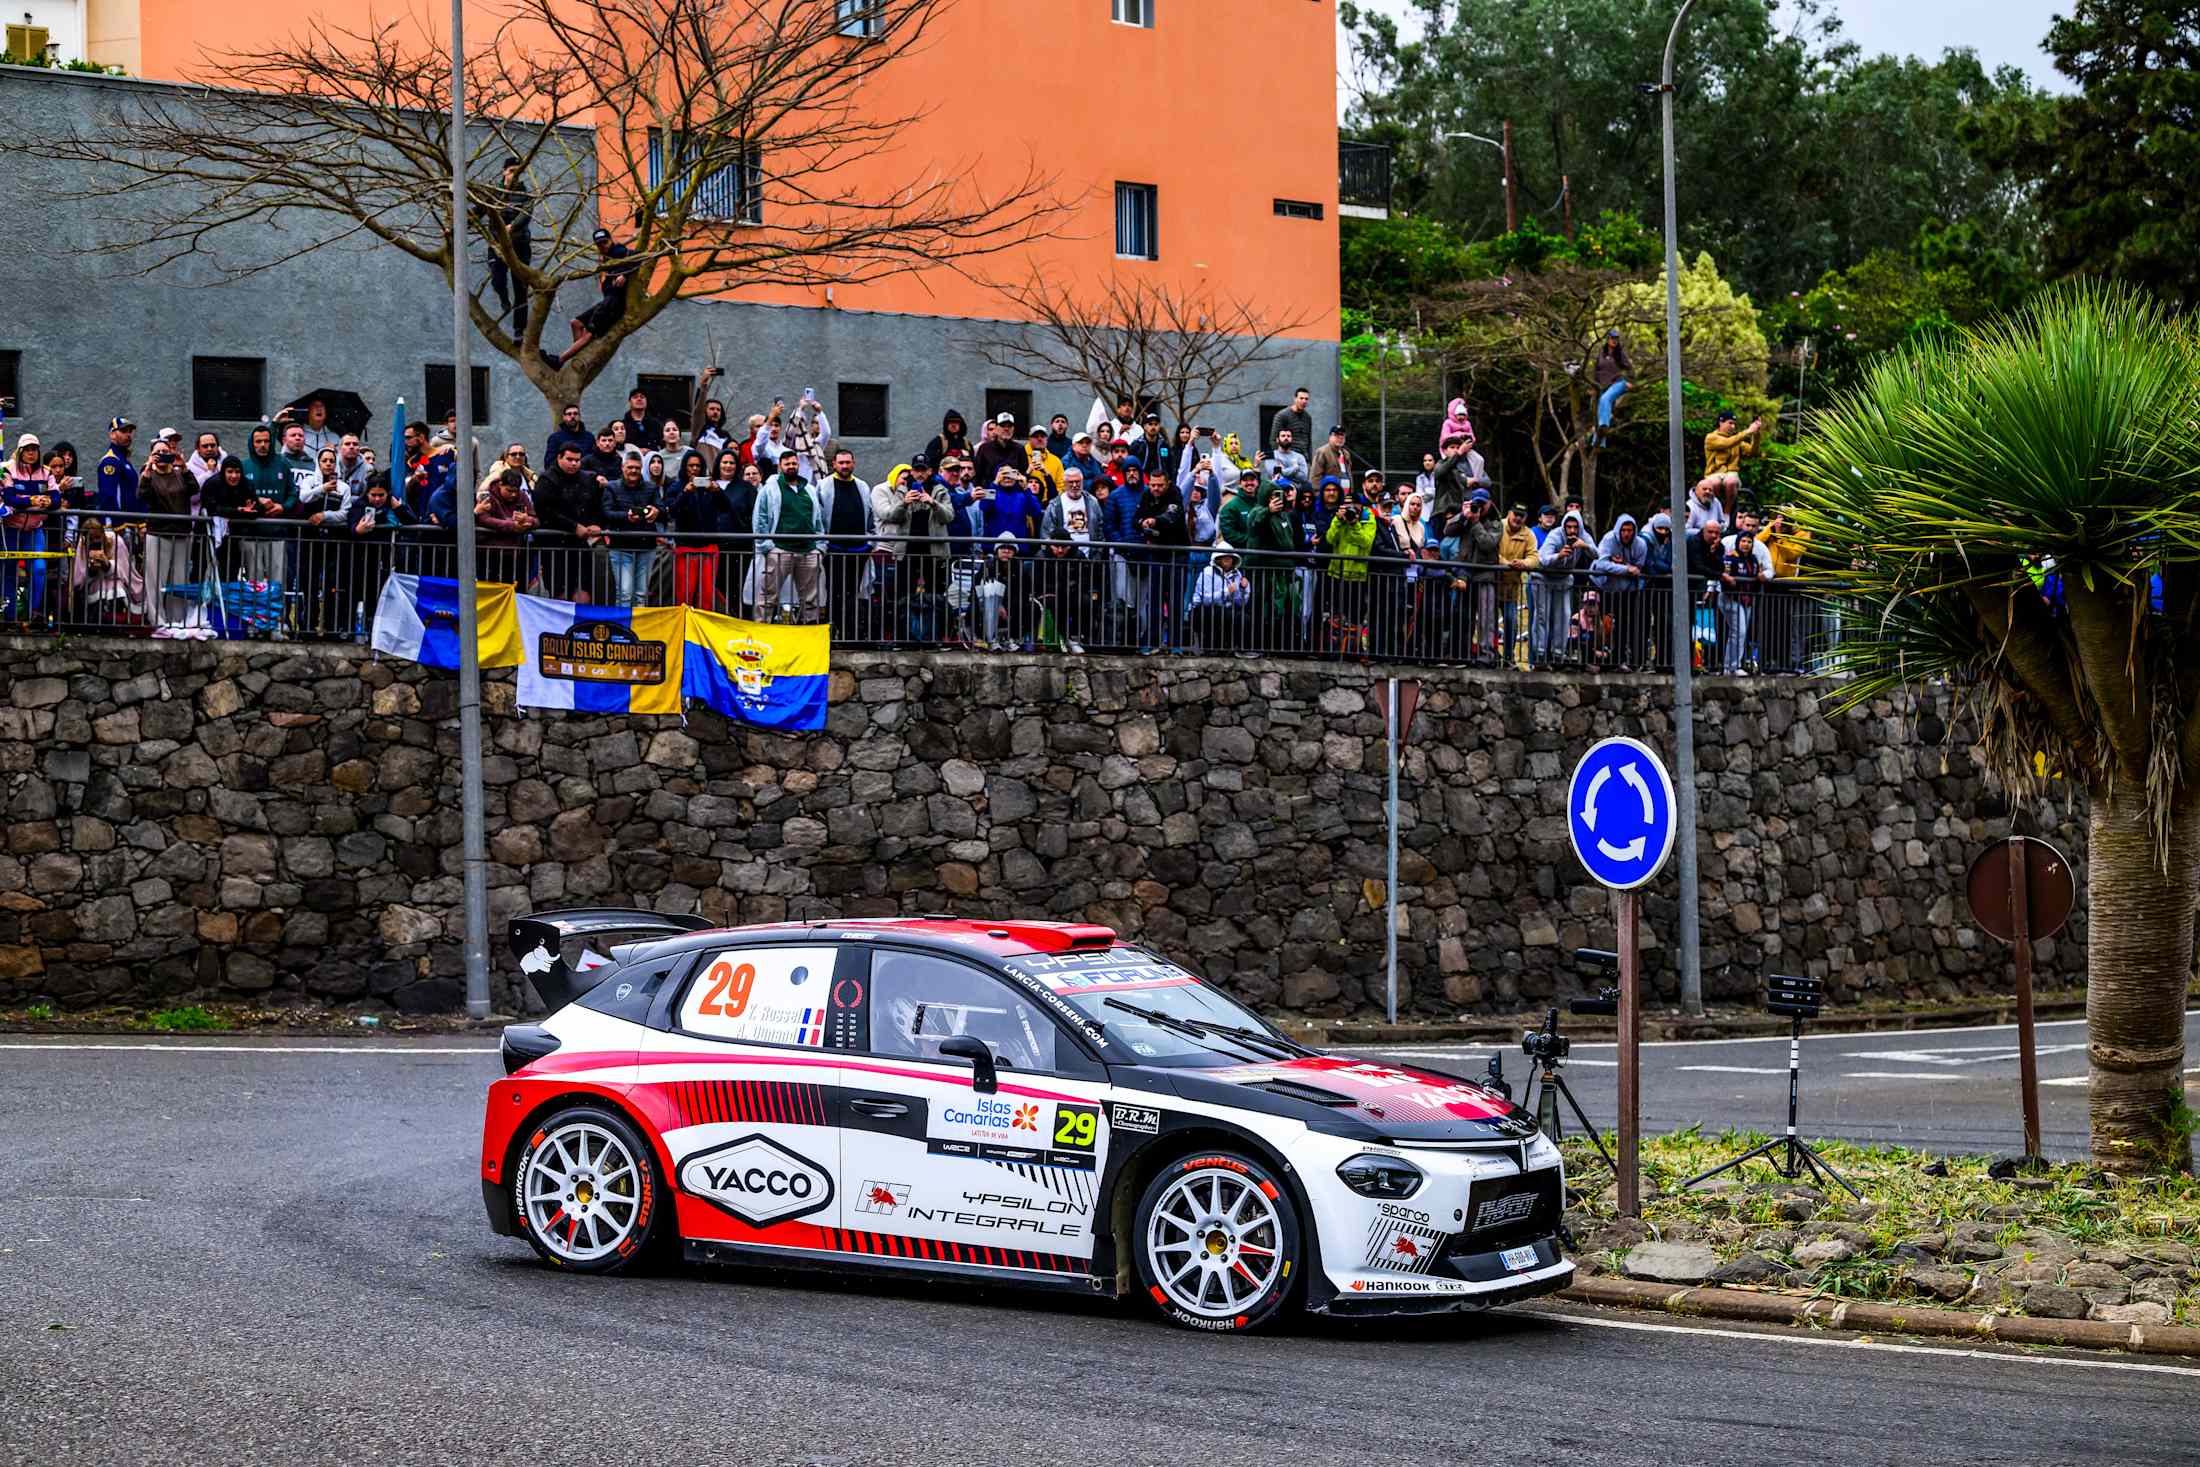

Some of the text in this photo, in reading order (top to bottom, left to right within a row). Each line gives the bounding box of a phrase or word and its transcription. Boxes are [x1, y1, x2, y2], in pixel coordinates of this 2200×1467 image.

[543, 637, 569, 656] RALLY
[572, 640, 604, 660] ISLAS
[606, 643, 662, 662] CANARIAS
[698, 961, 756, 1018] 29
[944, 1108, 1010, 1129] Canarias
[977, 1099, 1011, 1115] Islas
[1055, 1109, 1097, 1146] 29
[702, 1165, 812, 1199] YACCO
[962, 1191, 1089, 1216] YPSILON
[1381, 1203, 1431, 1223] sparco
[907, 1206, 1082, 1237] INTEGRALE
